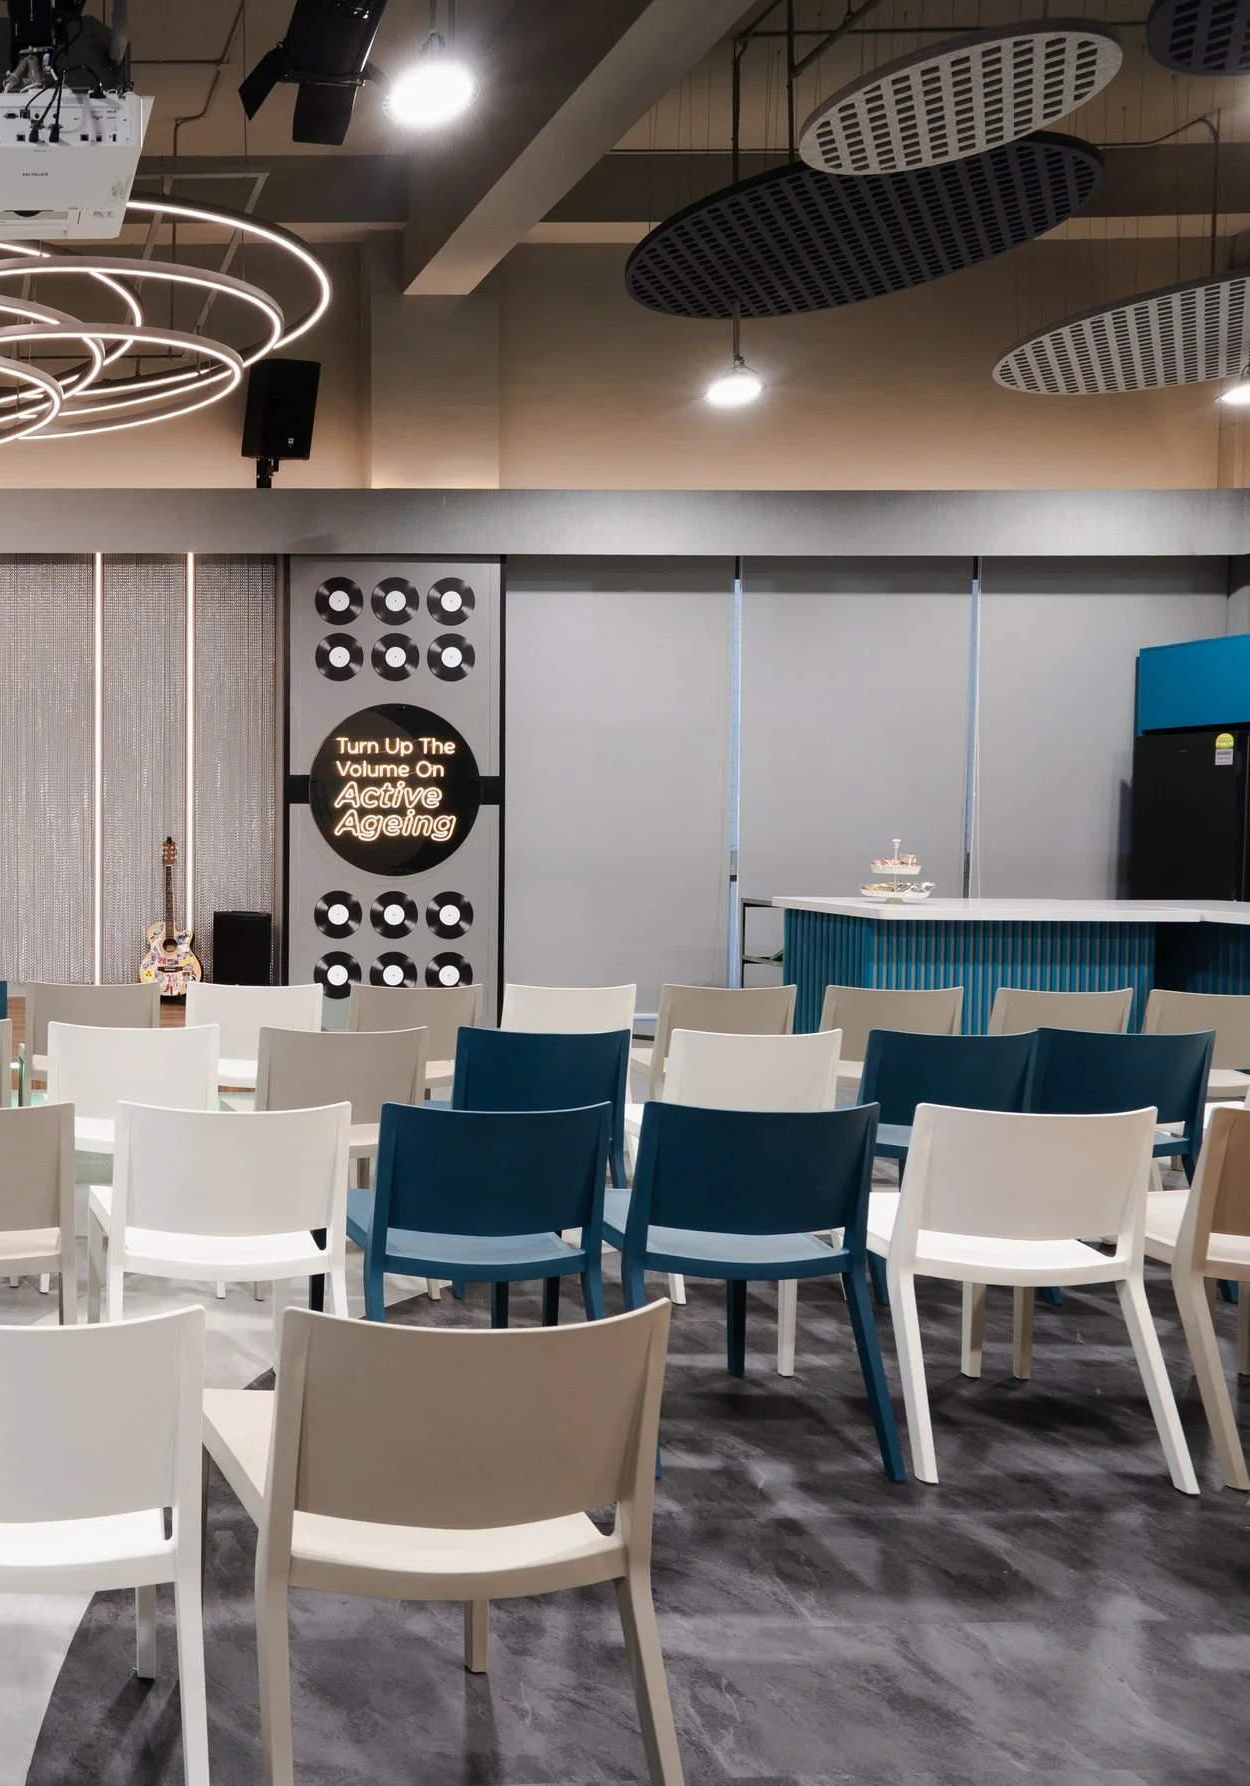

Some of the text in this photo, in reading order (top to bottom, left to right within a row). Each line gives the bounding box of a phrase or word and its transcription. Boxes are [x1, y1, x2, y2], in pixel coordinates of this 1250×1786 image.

[335, 737, 456, 757] Turn Up The
[336, 760, 445, 777] Volume On
[334, 781, 443, 809] Active
[334, 809, 457, 841] Ageing
